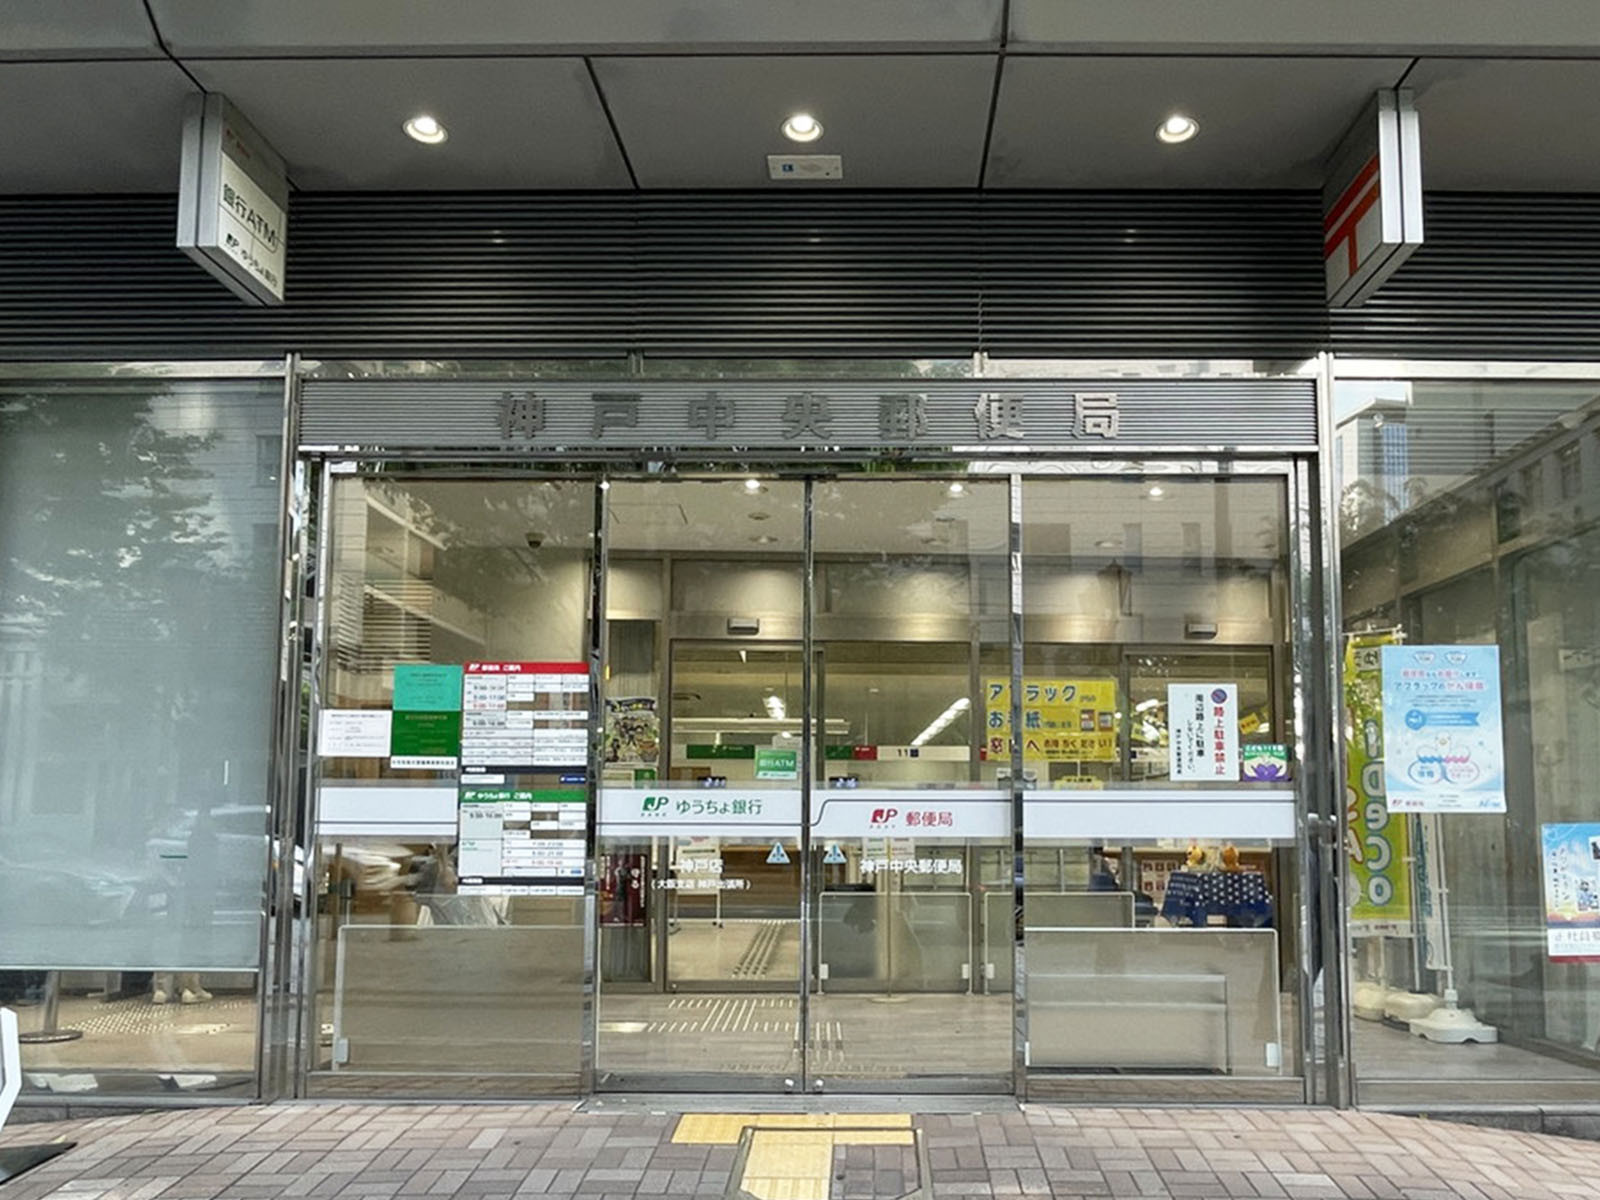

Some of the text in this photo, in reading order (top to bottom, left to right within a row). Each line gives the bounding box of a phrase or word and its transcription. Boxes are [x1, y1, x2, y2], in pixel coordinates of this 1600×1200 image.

[223, 183, 276, 247] 銀行ATM
[496, 391, 1120, 440] 神戸中央郵便局
[989, 684, 1076, 702] アラック
[989, 711, 1041, 728] お紙
[642, 796, 762, 815] JP ゆうちょ銀行
[871, 808, 953, 827] JP 郵便局
[680, 858, 724, 874] 神戸店
[860, 858, 963, 874] 神戸中央郵便局
